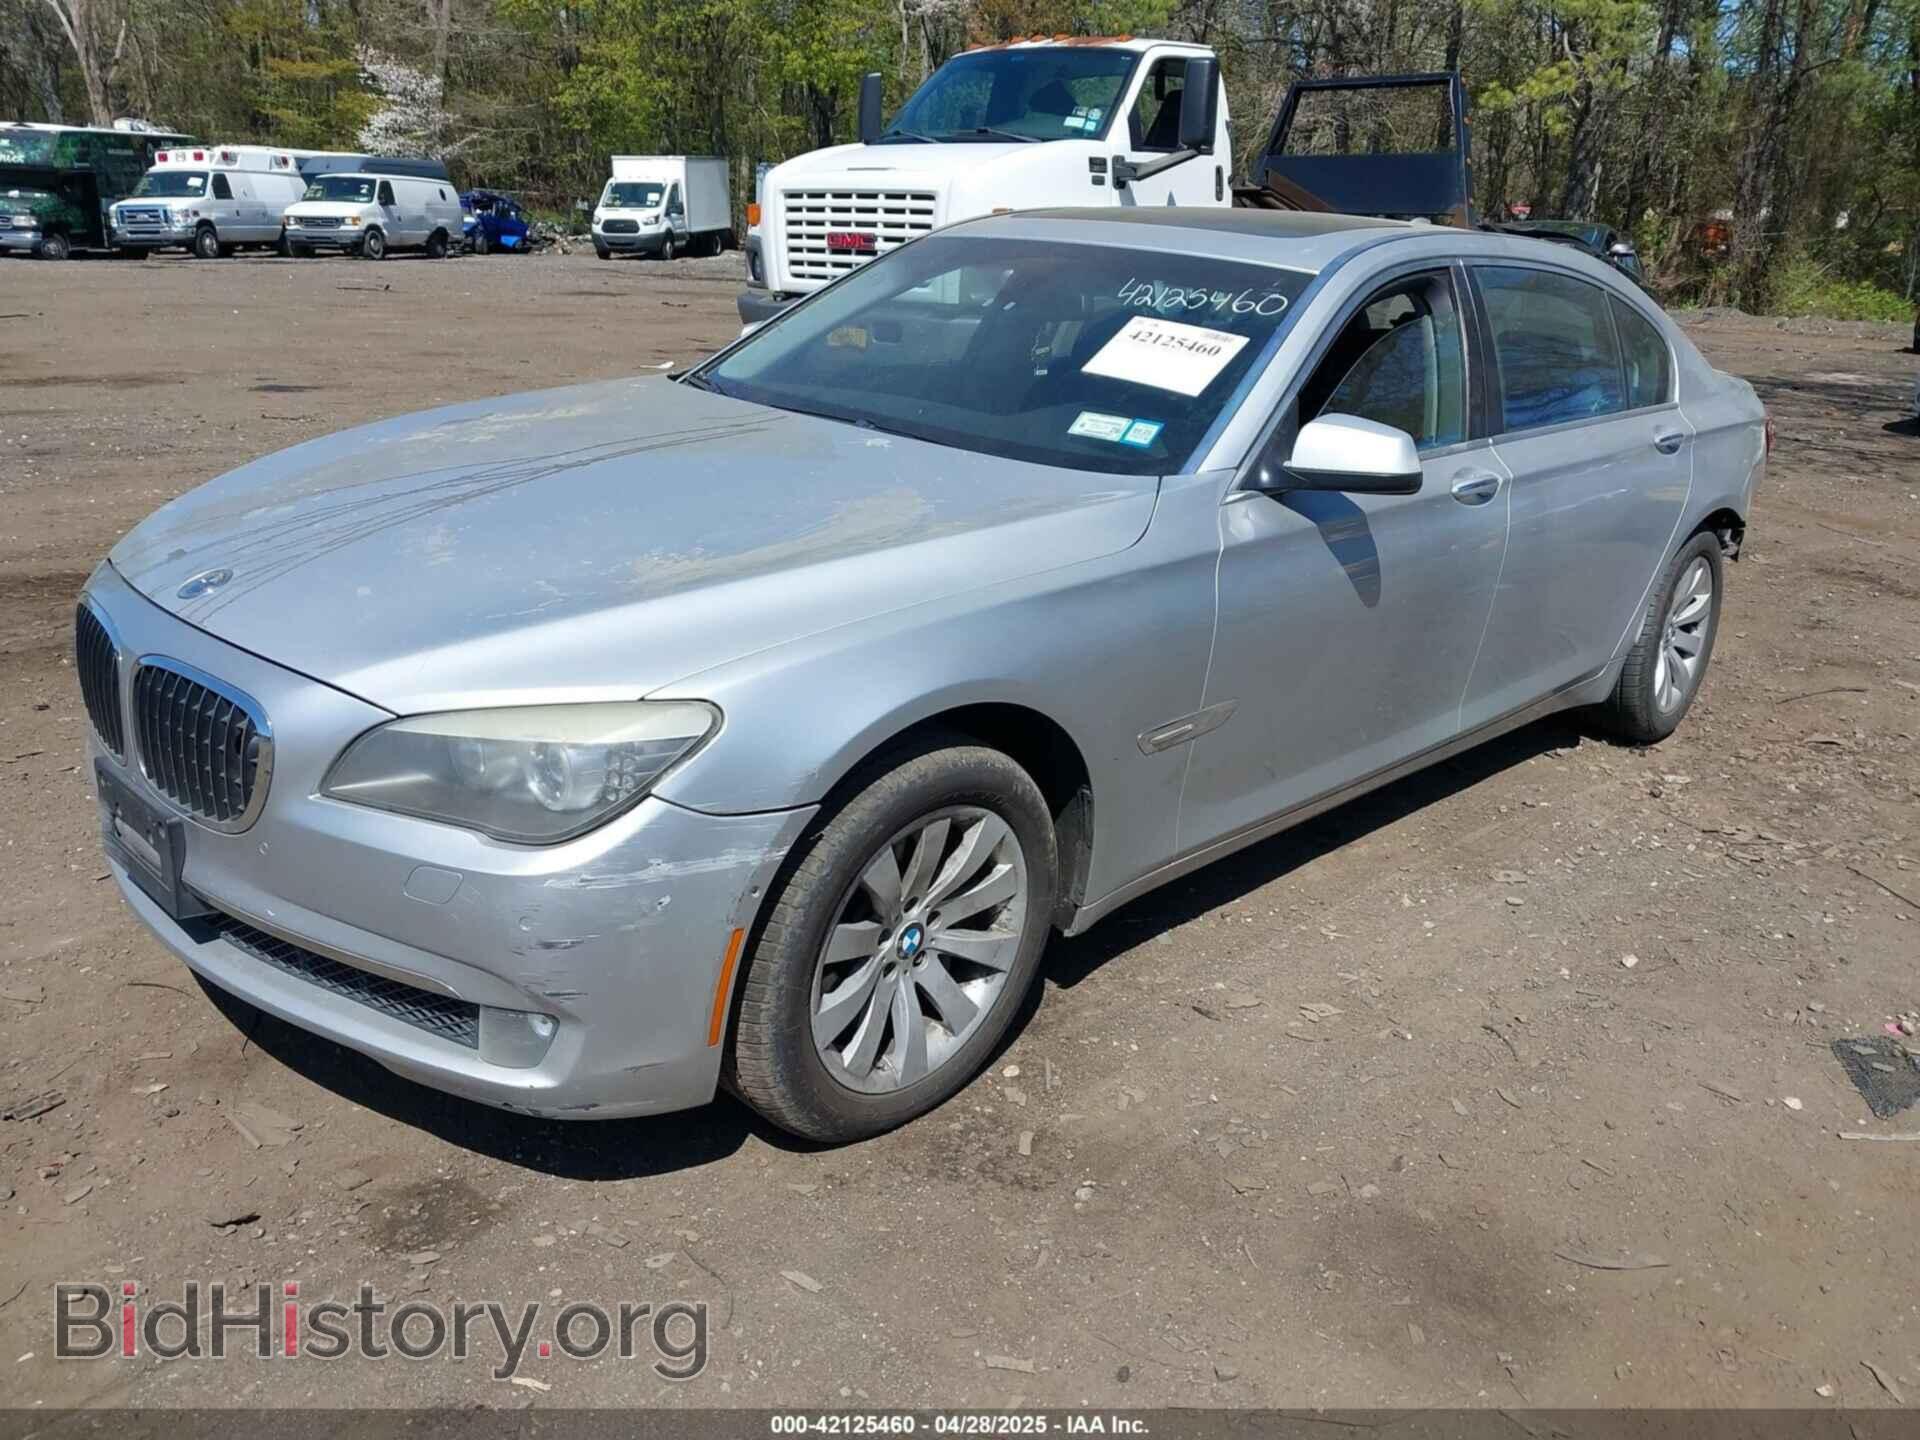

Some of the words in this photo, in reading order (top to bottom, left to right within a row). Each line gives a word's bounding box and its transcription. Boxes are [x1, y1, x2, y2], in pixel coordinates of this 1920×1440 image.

[827, 232, 875, 249] GMC
[1118, 277, 1288, 316] 42125460
[1129, 330, 1222, 357] 42125460
